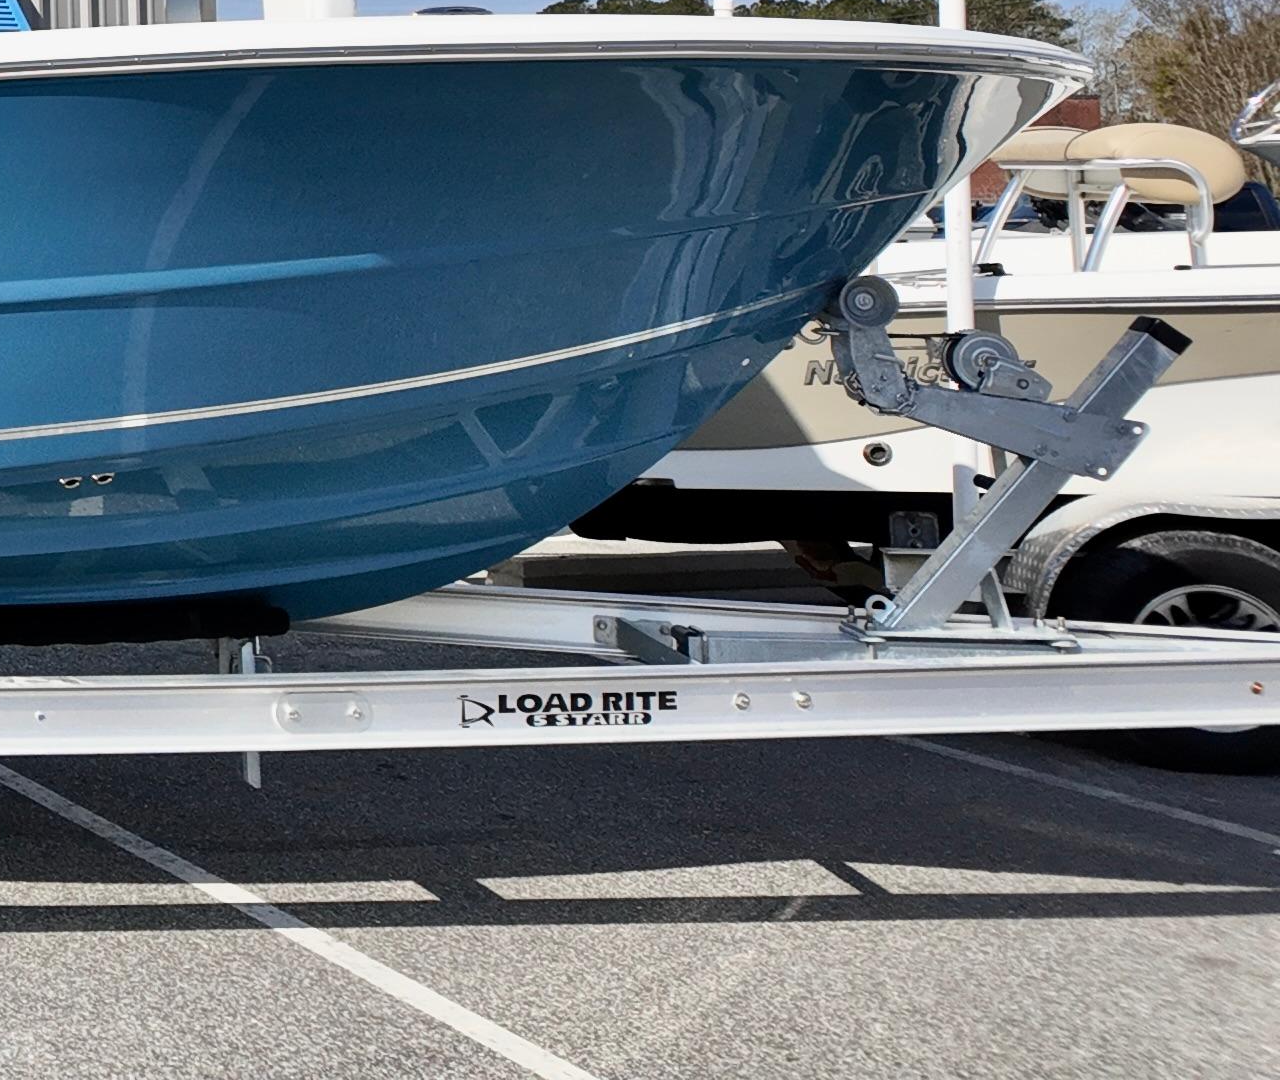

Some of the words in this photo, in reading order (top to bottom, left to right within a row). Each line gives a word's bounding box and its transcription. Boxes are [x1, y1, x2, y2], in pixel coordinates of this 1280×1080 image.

[498, 693, 593, 714] LOAD
[602, 691, 678, 711] RITE
[555, 712, 645, 726] STARR
